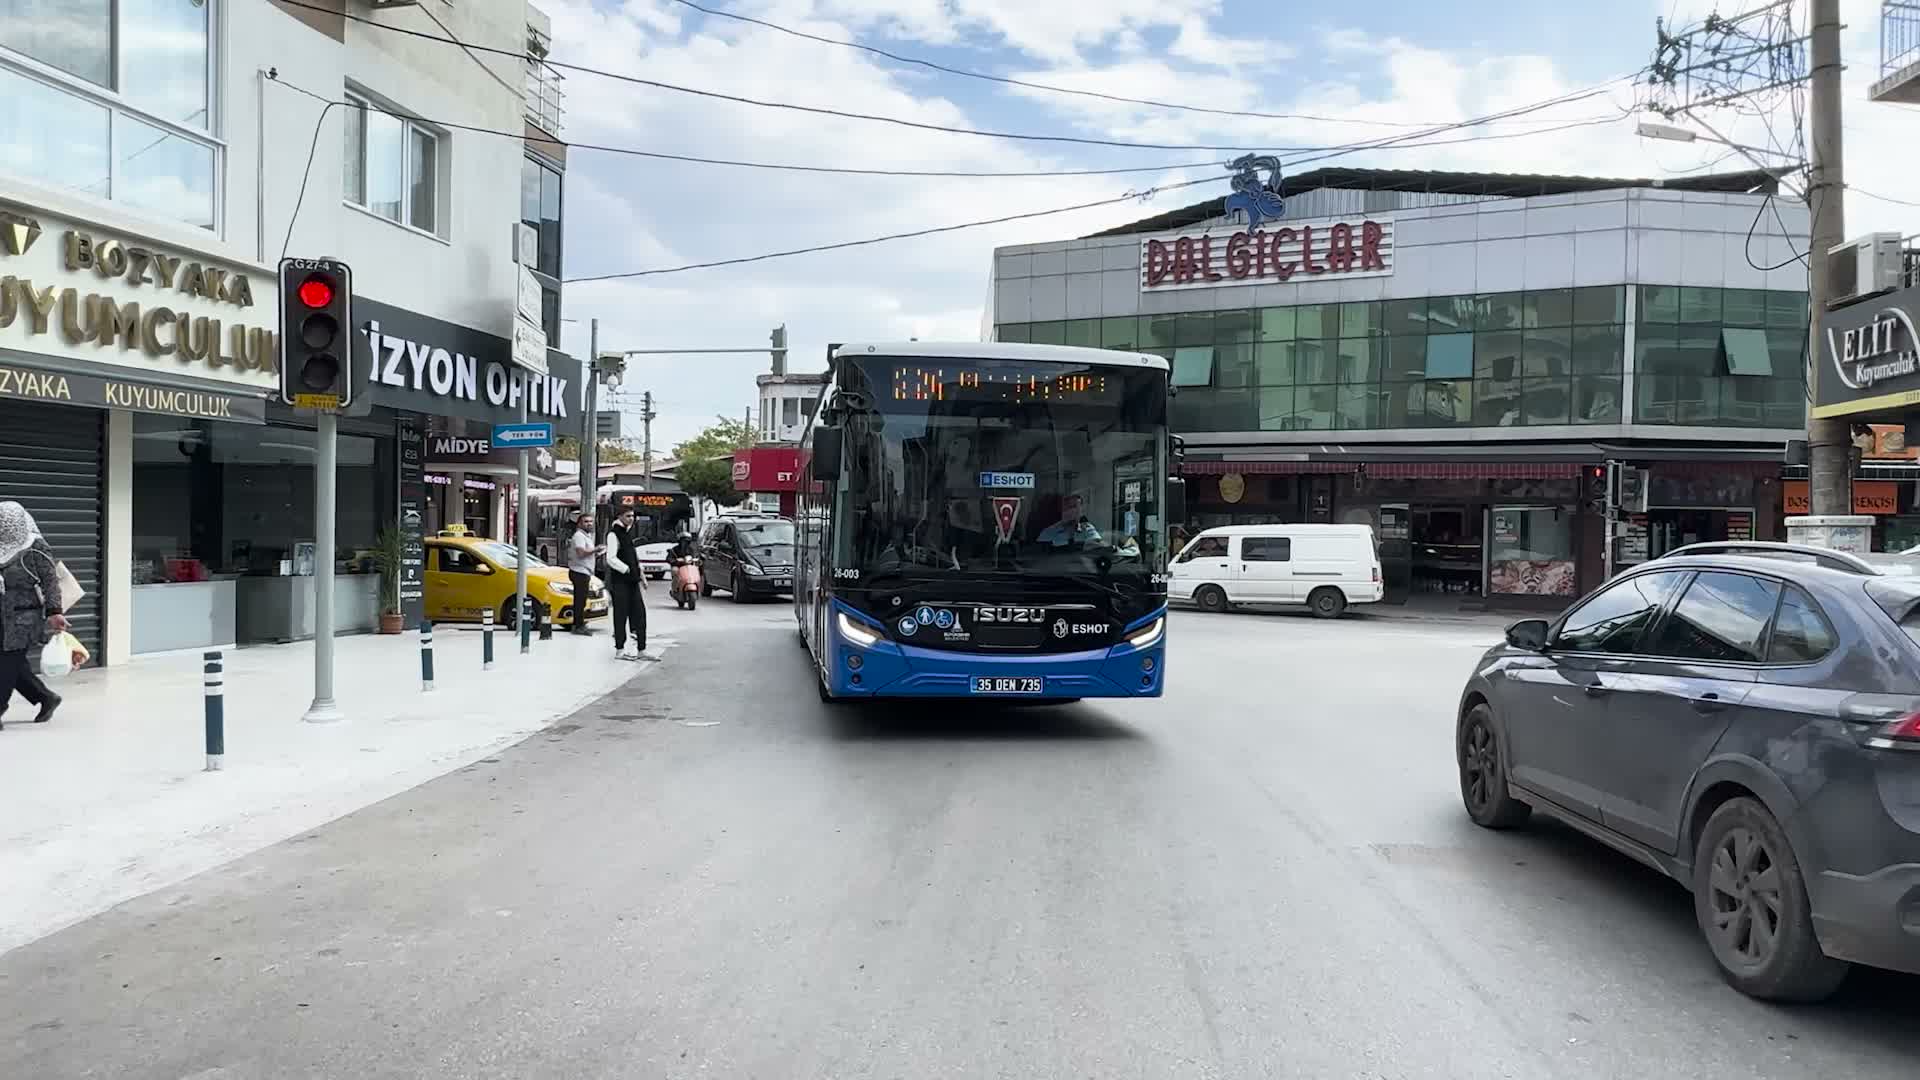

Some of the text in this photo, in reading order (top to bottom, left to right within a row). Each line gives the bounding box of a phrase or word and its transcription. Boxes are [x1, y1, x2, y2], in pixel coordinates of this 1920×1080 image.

[65, 230, 253, 307] BOZYAKA
[1842, 313, 1897, 363] ELİT
[361, 320, 477, 401] İZYON
[105, 382, 231, 418] KUYUMCULUK
[435, 436, 489, 454] MİDYE
[993, 475, 1032, 486] ESHOT
[834, 568, 859, 579] 26-003
[973, 607, 1045, 622] ISUZU
[1072, 624, 1110, 634] ESHOT
[978, 679, 991, 691] 35
[1021, 679, 1040, 691] 735
